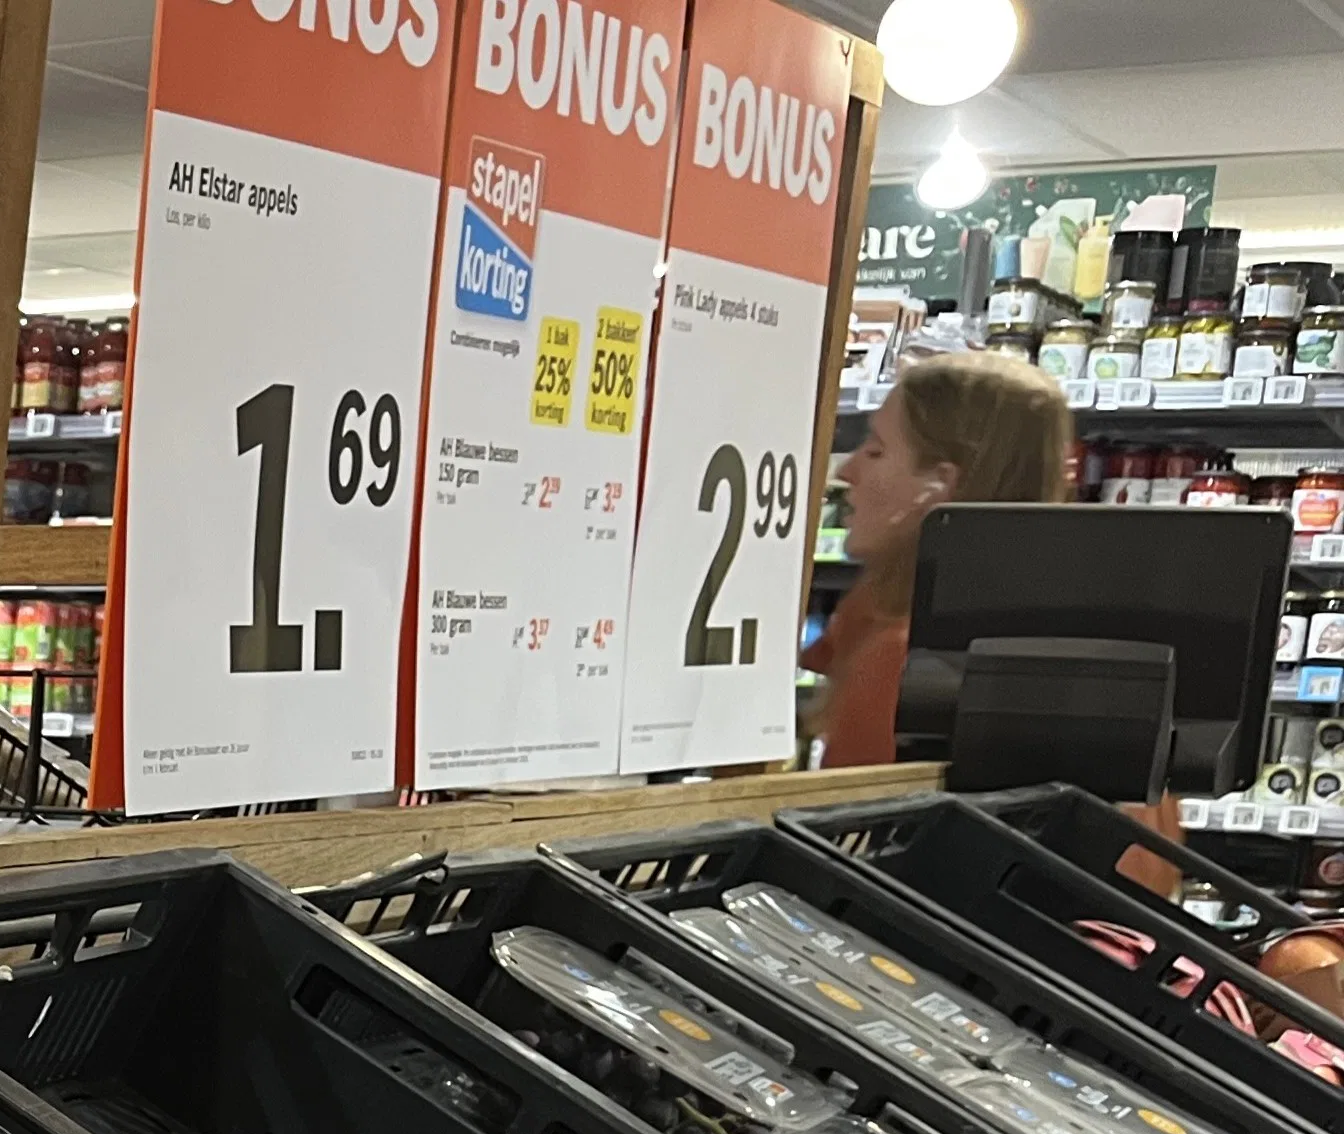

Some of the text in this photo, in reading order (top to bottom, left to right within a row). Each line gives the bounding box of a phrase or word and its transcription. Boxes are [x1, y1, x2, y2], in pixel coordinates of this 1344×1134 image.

[475, 0, 671, 146] BONUS
[693, 63, 835, 205] BONUS
[169, 162, 298, 217] AH Elstar appels
[472, 152, 540, 226] stapel
[460, 225, 528, 314] korting
[720, 297, 748, 322] appels
[534, 355, 572, 396] 25%
[591, 350, 635, 399] 50%
[535, 401, 565, 424] korting
[591, 402, 627, 433] korting
[229, 383, 402, 674] 1.69
[684, 444, 797, 666] 2.99
